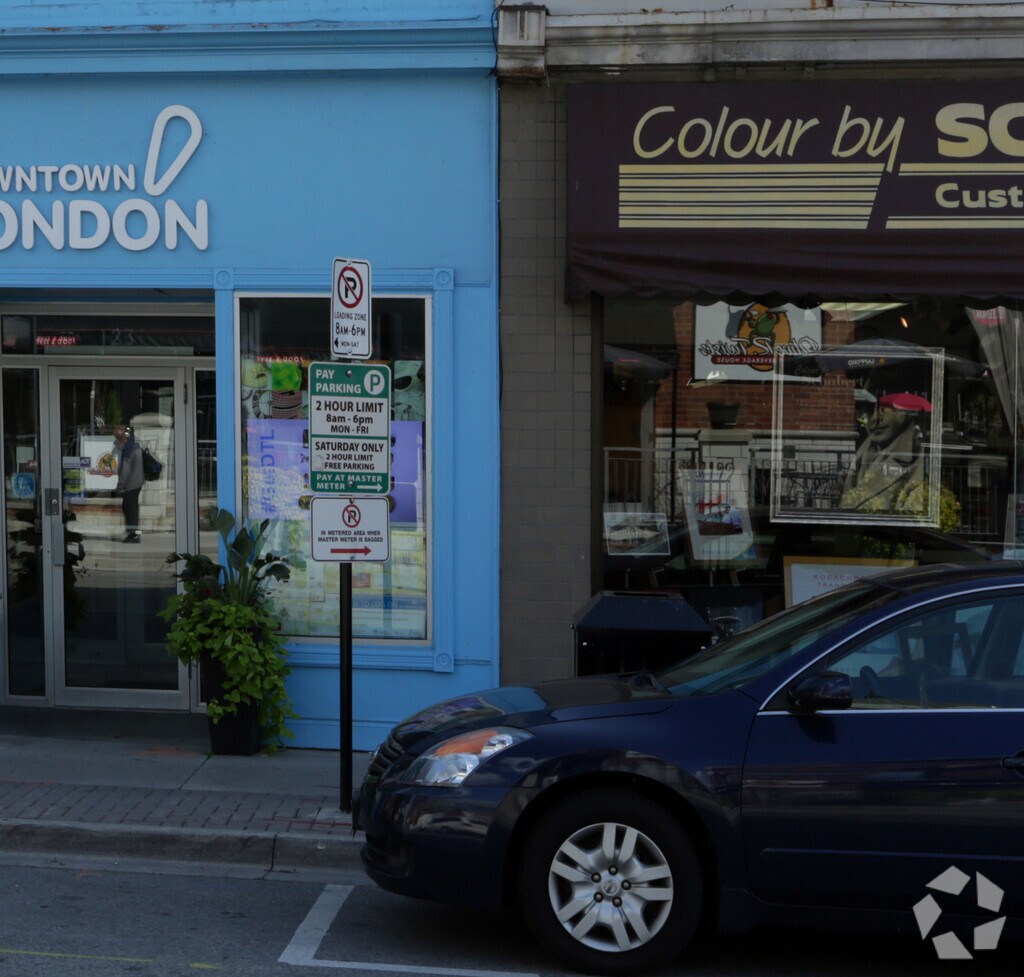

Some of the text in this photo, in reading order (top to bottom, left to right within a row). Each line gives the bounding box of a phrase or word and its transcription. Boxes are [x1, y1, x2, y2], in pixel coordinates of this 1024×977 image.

[633, 105, 820, 159] Colour
[831, 104, 905, 173] by
[935, 183, 1024, 208] Cust
[335, 312, 367, 321] LOADING ZONE
[316, 369, 335, 379] PAY
[316, 383, 361, 394] PARKING
[316, 400, 384, 413] 2 HOUR LIMIT
[326, 414, 346, 423] 8am
[353, 415, 373, 425] 6pm
[330, 425, 350, 433] MON
[356, 426, 369, 434] FRI
[315, 441, 384, 453] SATURDAY ONLY
[324, 462, 375, 471] FREE PARKING
[316, 474, 383, 482] PAY AT MASTER
[316, 482, 345, 490] METER
